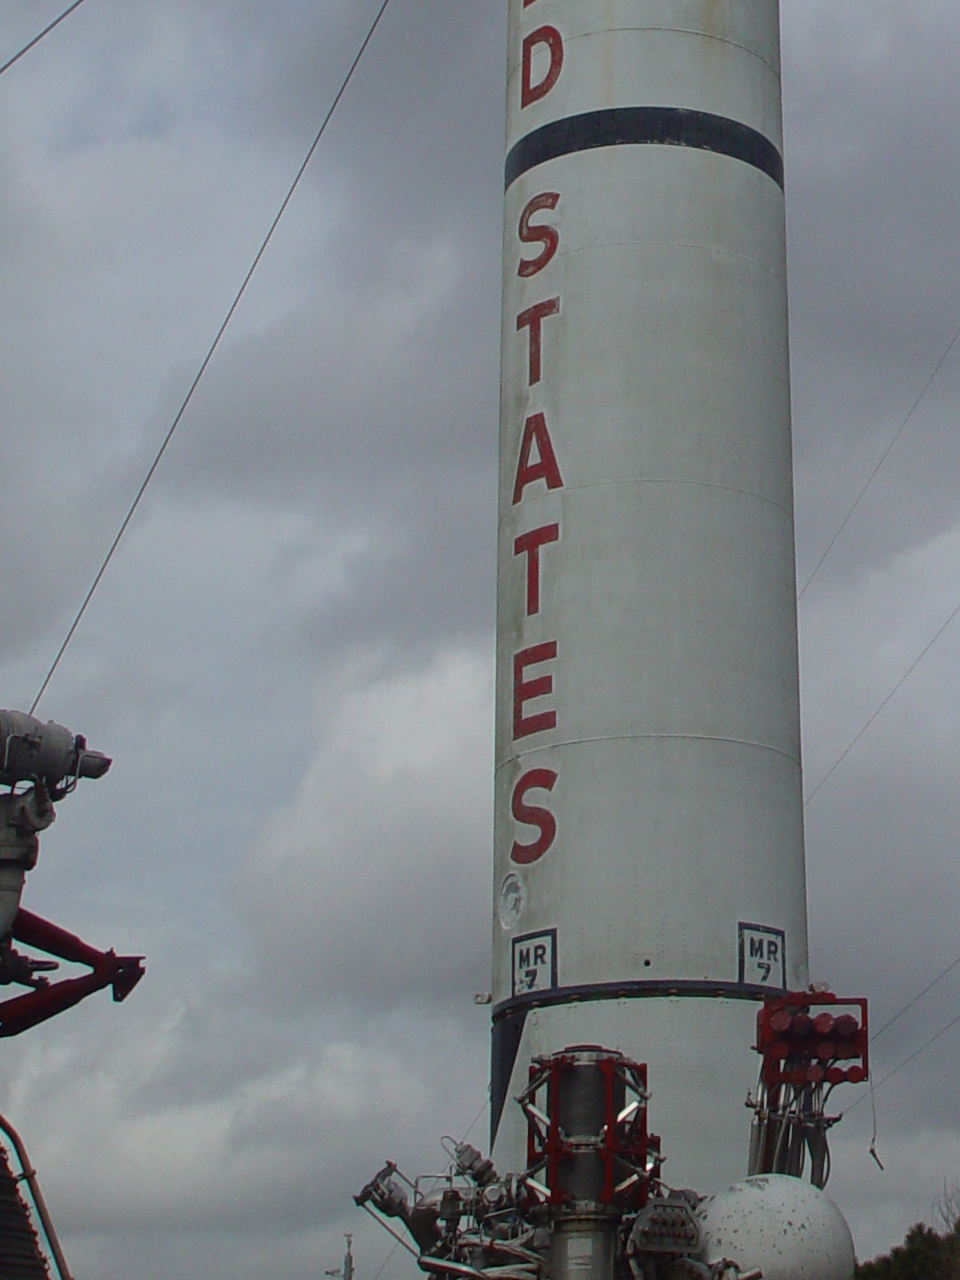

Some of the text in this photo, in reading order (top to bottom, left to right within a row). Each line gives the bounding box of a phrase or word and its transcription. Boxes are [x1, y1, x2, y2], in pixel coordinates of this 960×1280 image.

[509, 191, 565, 865] STATES
[518, 943, 547, 970] MR
[749, 936, 778, 962] MR
[524, 968, 538, 990] 7
[756, 961, 772, 982] 7
